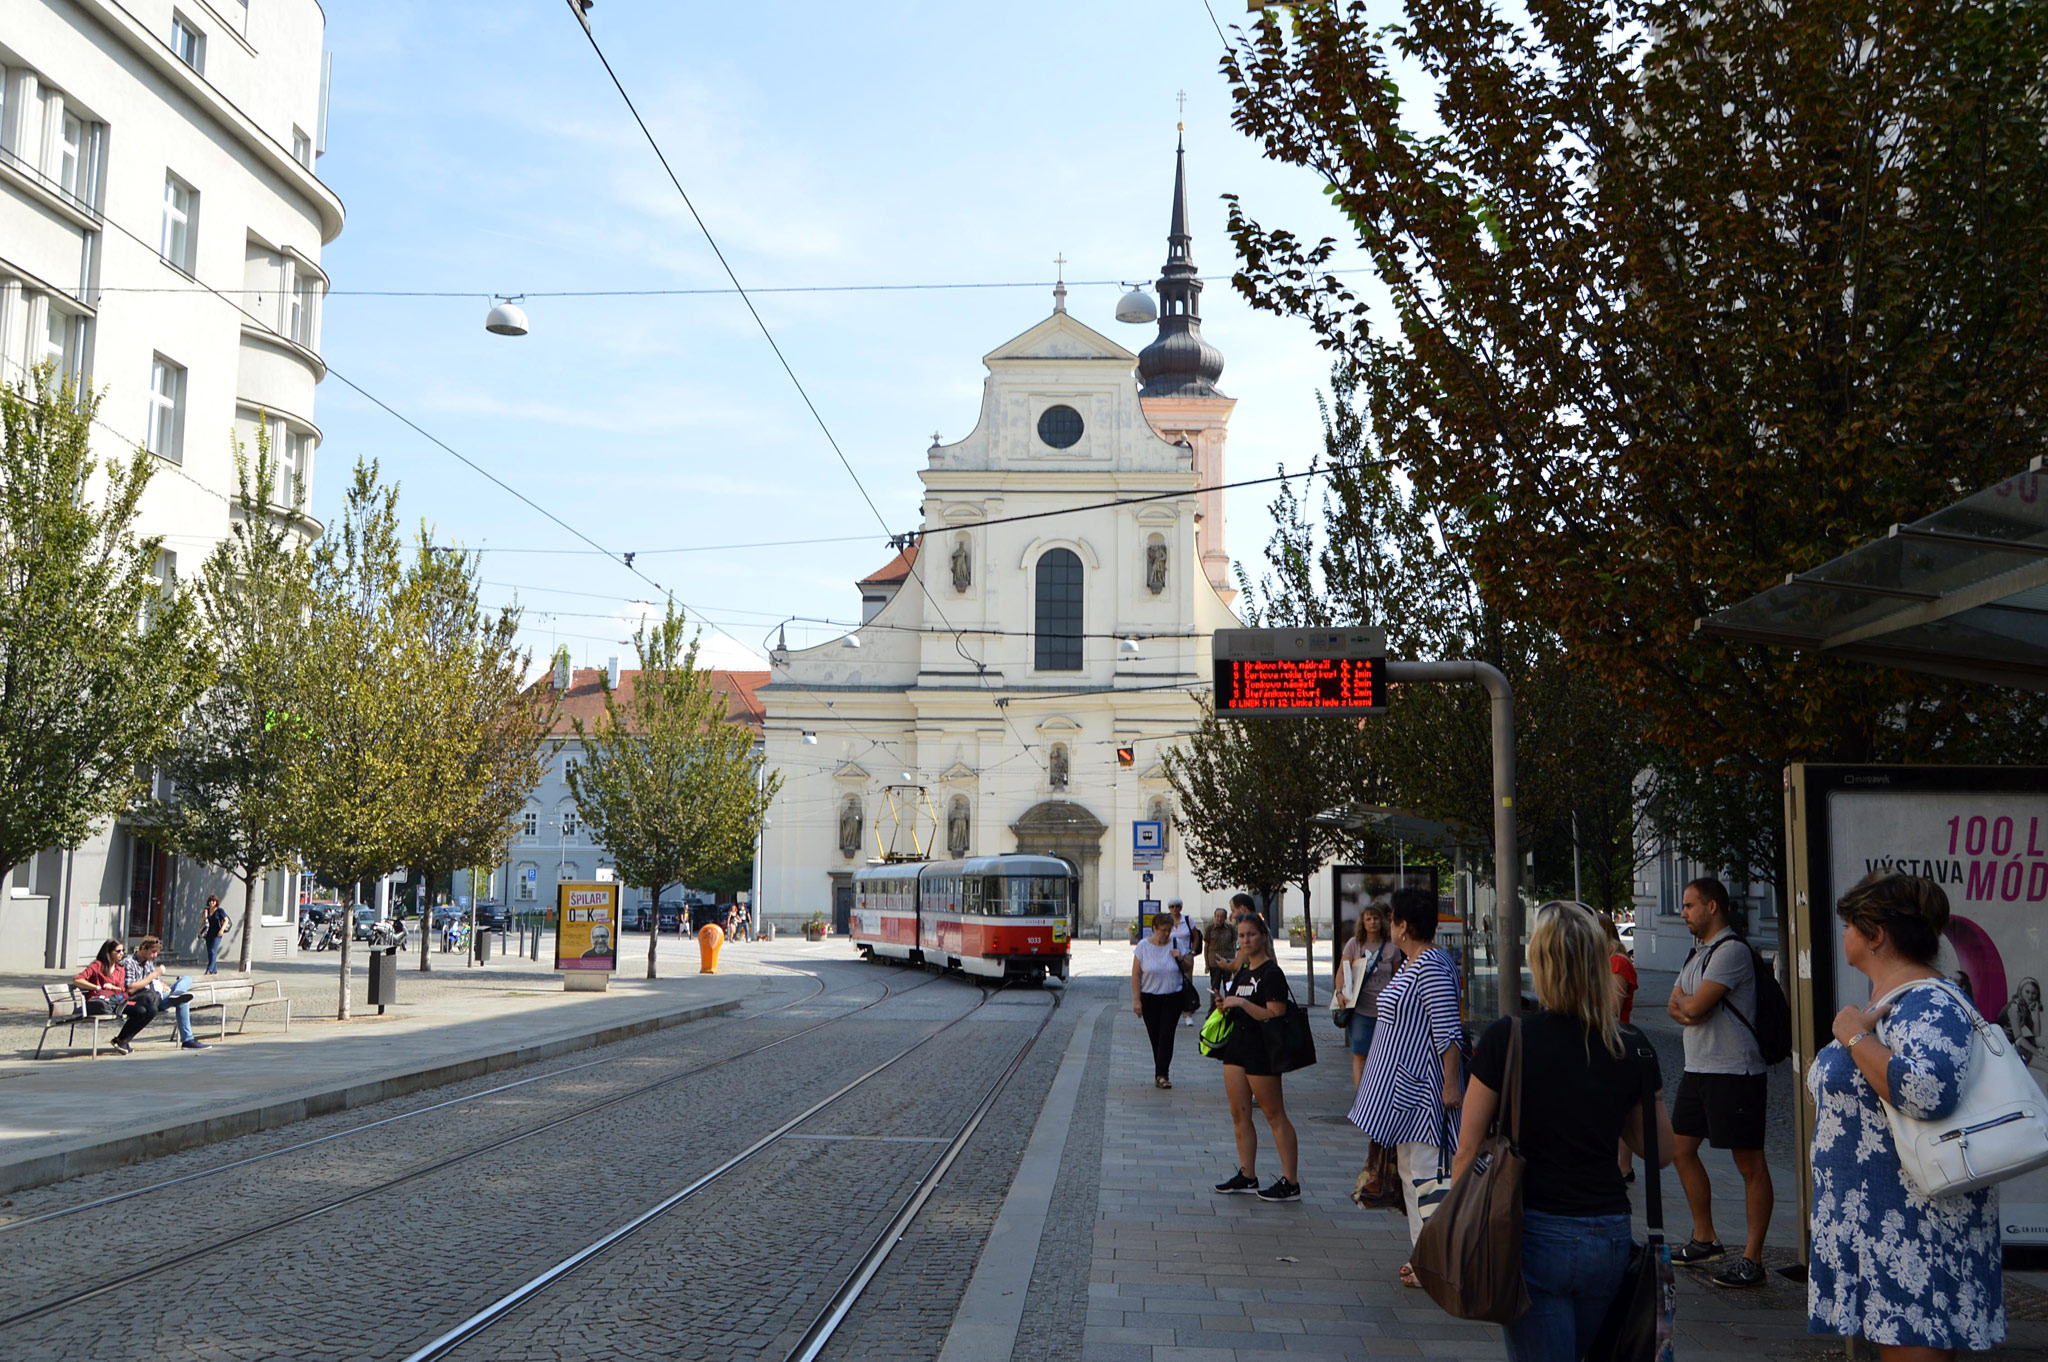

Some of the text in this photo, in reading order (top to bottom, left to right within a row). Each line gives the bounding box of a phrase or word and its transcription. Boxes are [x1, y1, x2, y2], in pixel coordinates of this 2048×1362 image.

[1244, 661, 1276, 670] Královo
[1354, 669, 1372, 678] 1min
[1354, 678, 1372, 687] 2min
[1354, 687, 1372, 697] 2min
[1291, 697, 1313, 708] Linka
[1947, 815, 2045, 857] 100 L
[1865, 853, 2048, 902] VÝSTAVA MÓD
[570, 892, 602, 906] ŠPILAR
[1236, 985, 1254, 996] PUMA
